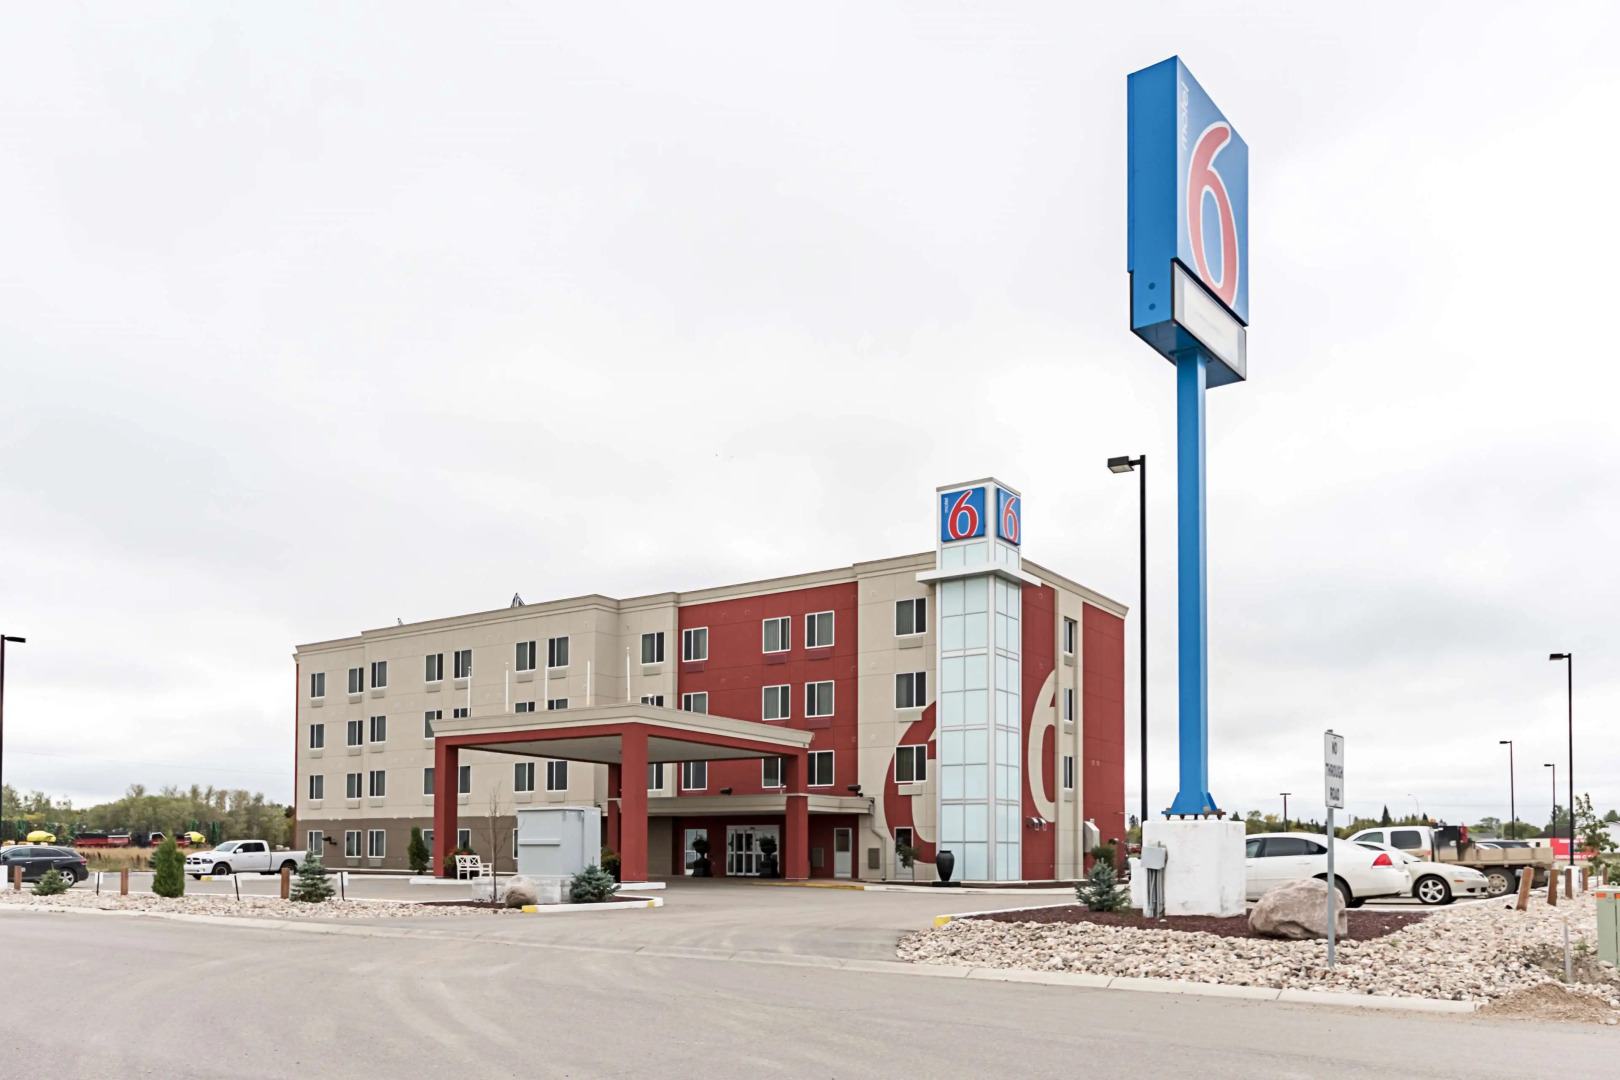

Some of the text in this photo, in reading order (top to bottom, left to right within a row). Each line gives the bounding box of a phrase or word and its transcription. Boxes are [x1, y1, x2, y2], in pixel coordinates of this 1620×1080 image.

[1188, 121, 1239, 309] 6
[948, 490, 979, 540] 6
[1003, 496, 1019, 543] 6
